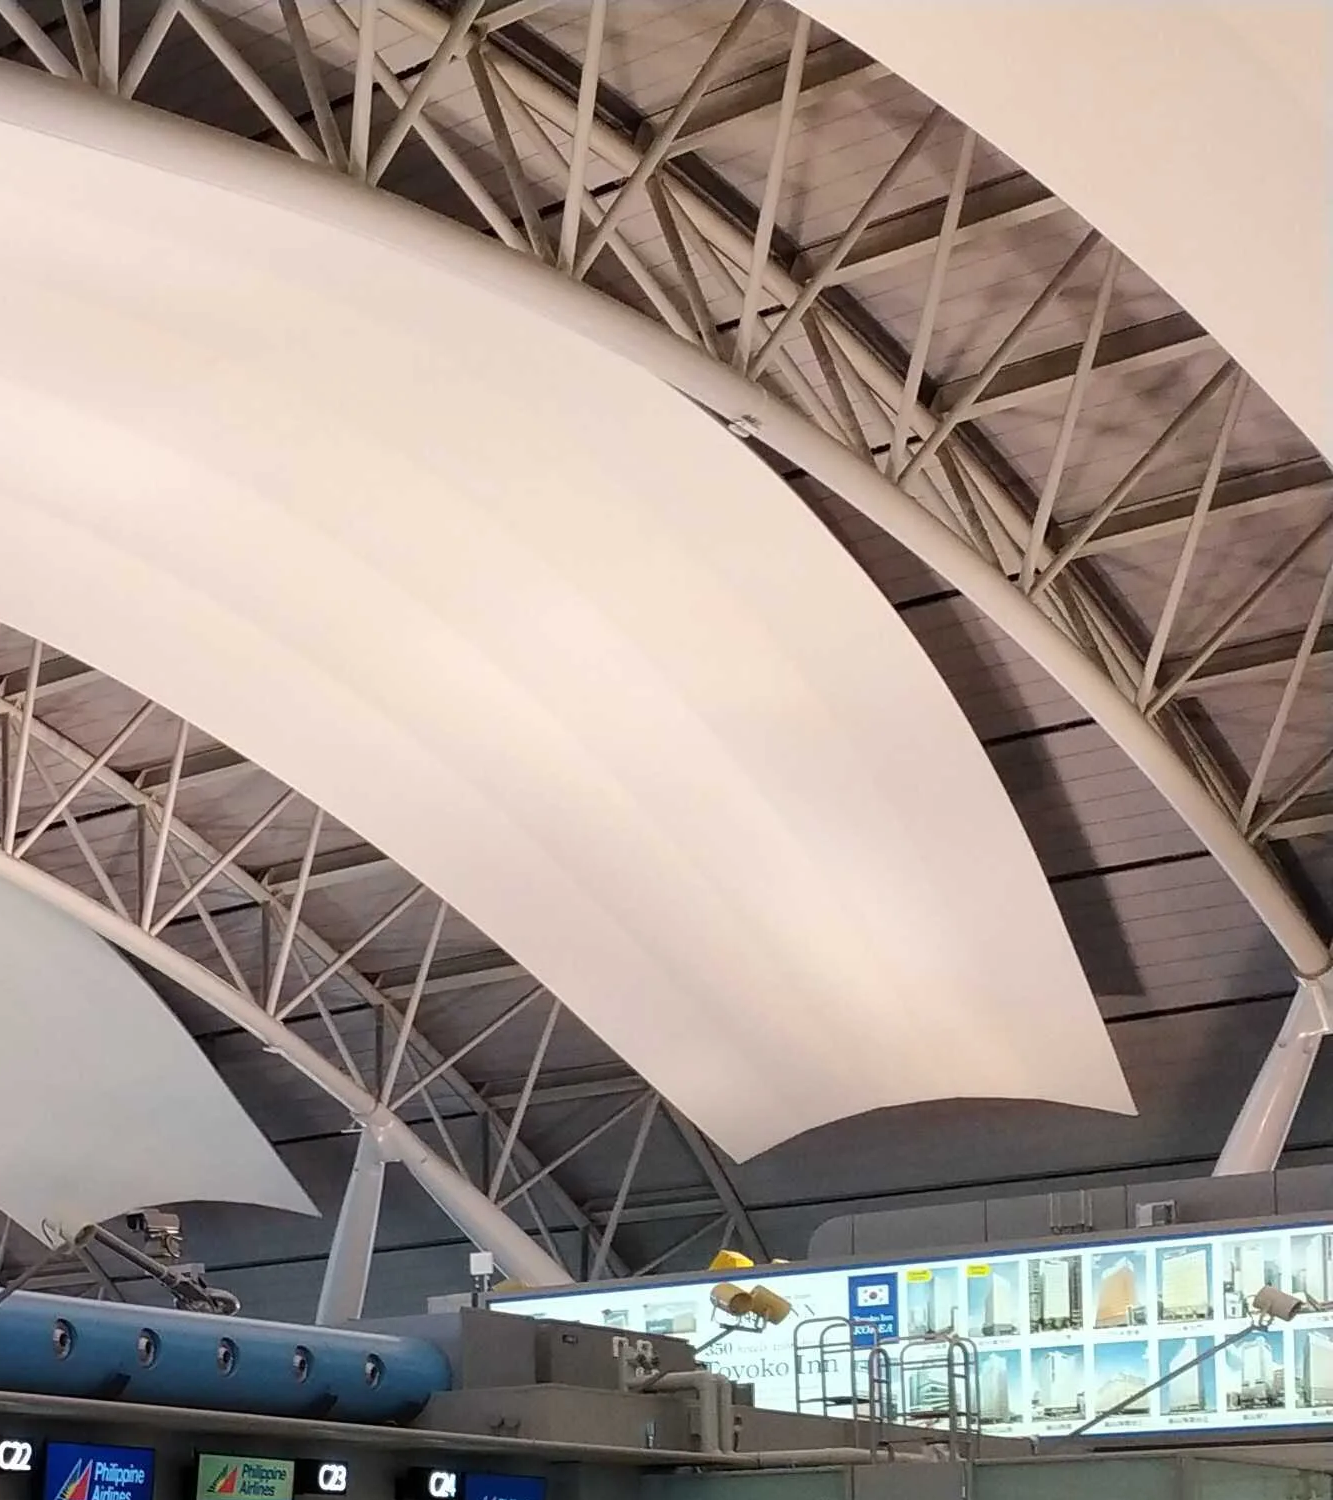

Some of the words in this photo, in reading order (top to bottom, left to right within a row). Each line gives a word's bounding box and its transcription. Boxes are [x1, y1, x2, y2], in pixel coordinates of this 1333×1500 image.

[94, 1462, 145, 1487] Philippine
[241, 1463, 287, 1484] Philippine
[318, 1464, 347, 1491] C23
[429, 1471, 457, 1498] C24
[240, 1480, 276, 1497] Airlines
